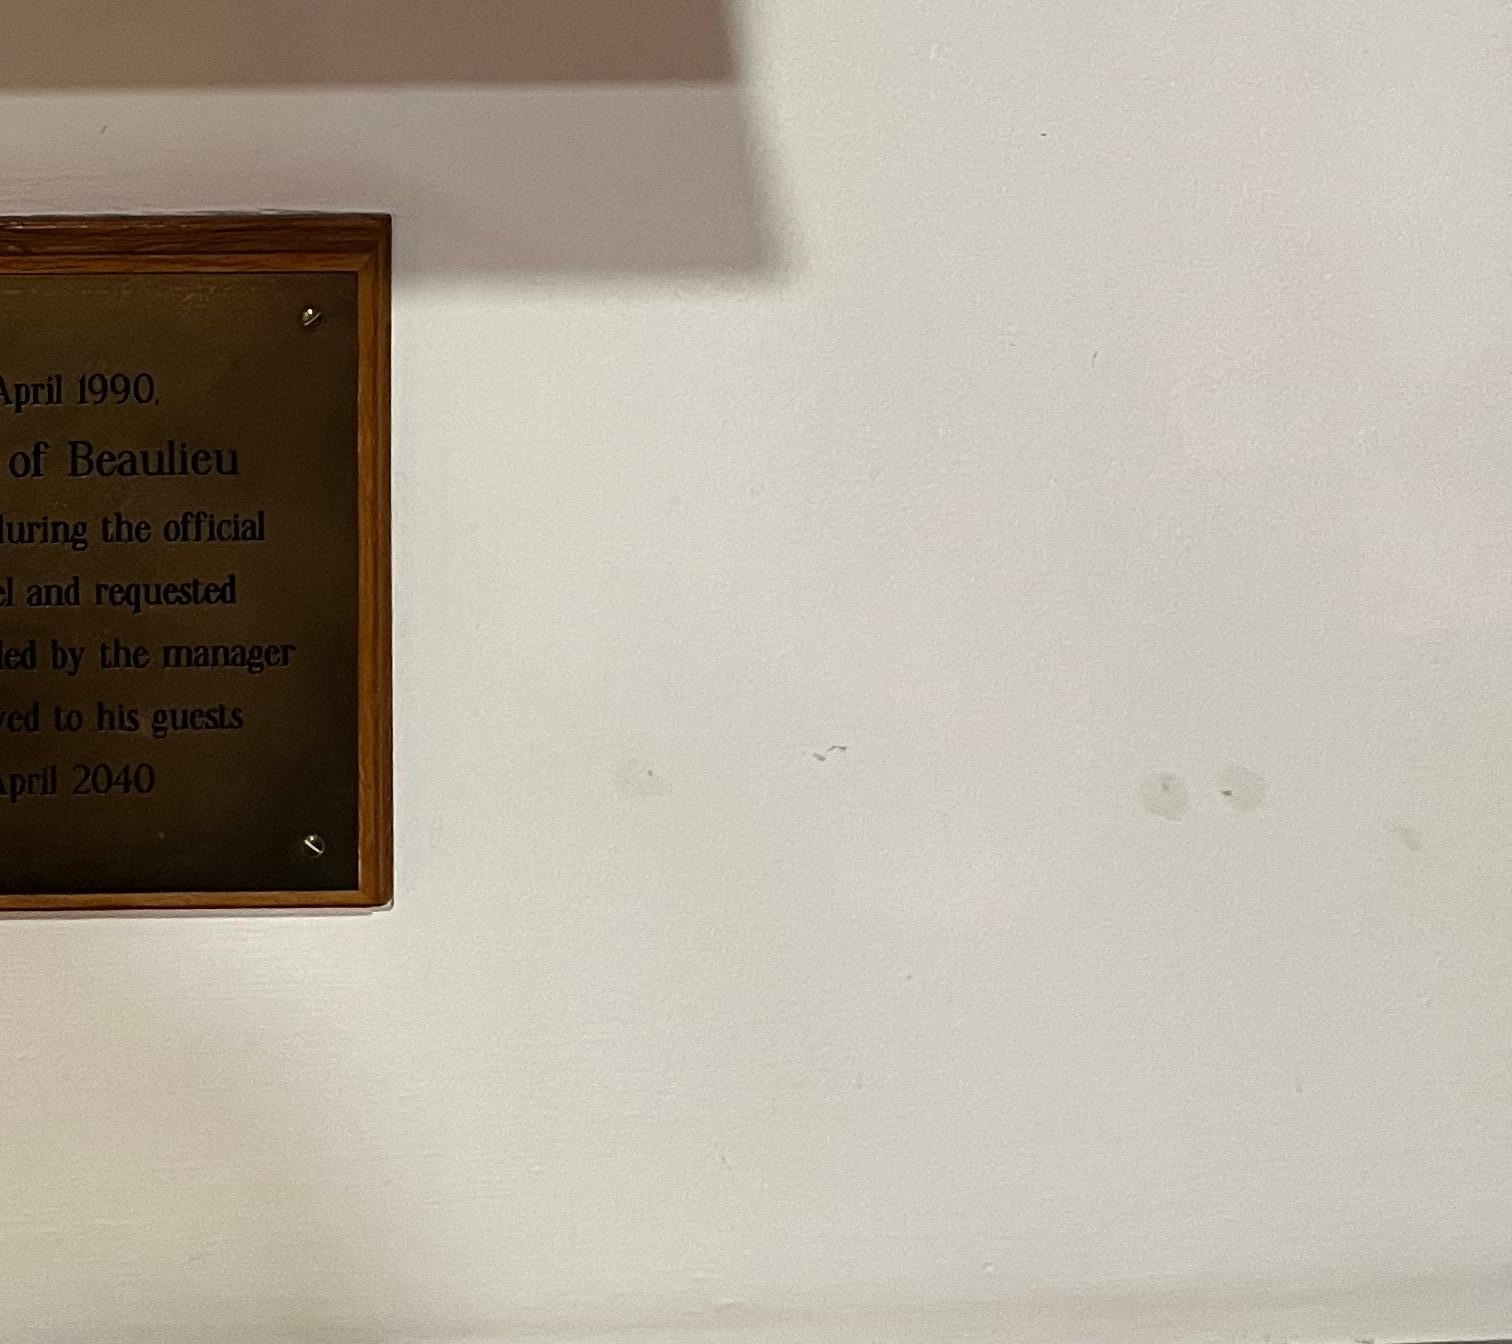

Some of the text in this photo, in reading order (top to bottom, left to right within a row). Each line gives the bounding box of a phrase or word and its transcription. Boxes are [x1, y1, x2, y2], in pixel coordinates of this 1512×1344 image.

[8, 440, 50, 478] of
[66, 439, 240, 478] Beaulieu
[101, 511, 152, 544] the
[163, 510, 266, 542] official
[26, 575, 81, 607] and
[94, 573, 237, 615] requested
[50, 638, 86, 677] by
[100, 637, 151, 669] the
[162, 644, 297, 675] manager
[53, 705, 83, 732] to
[96, 700, 140, 732] his
[151, 703, 244, 740] guests
[72, 762, 156, 795] 2040
